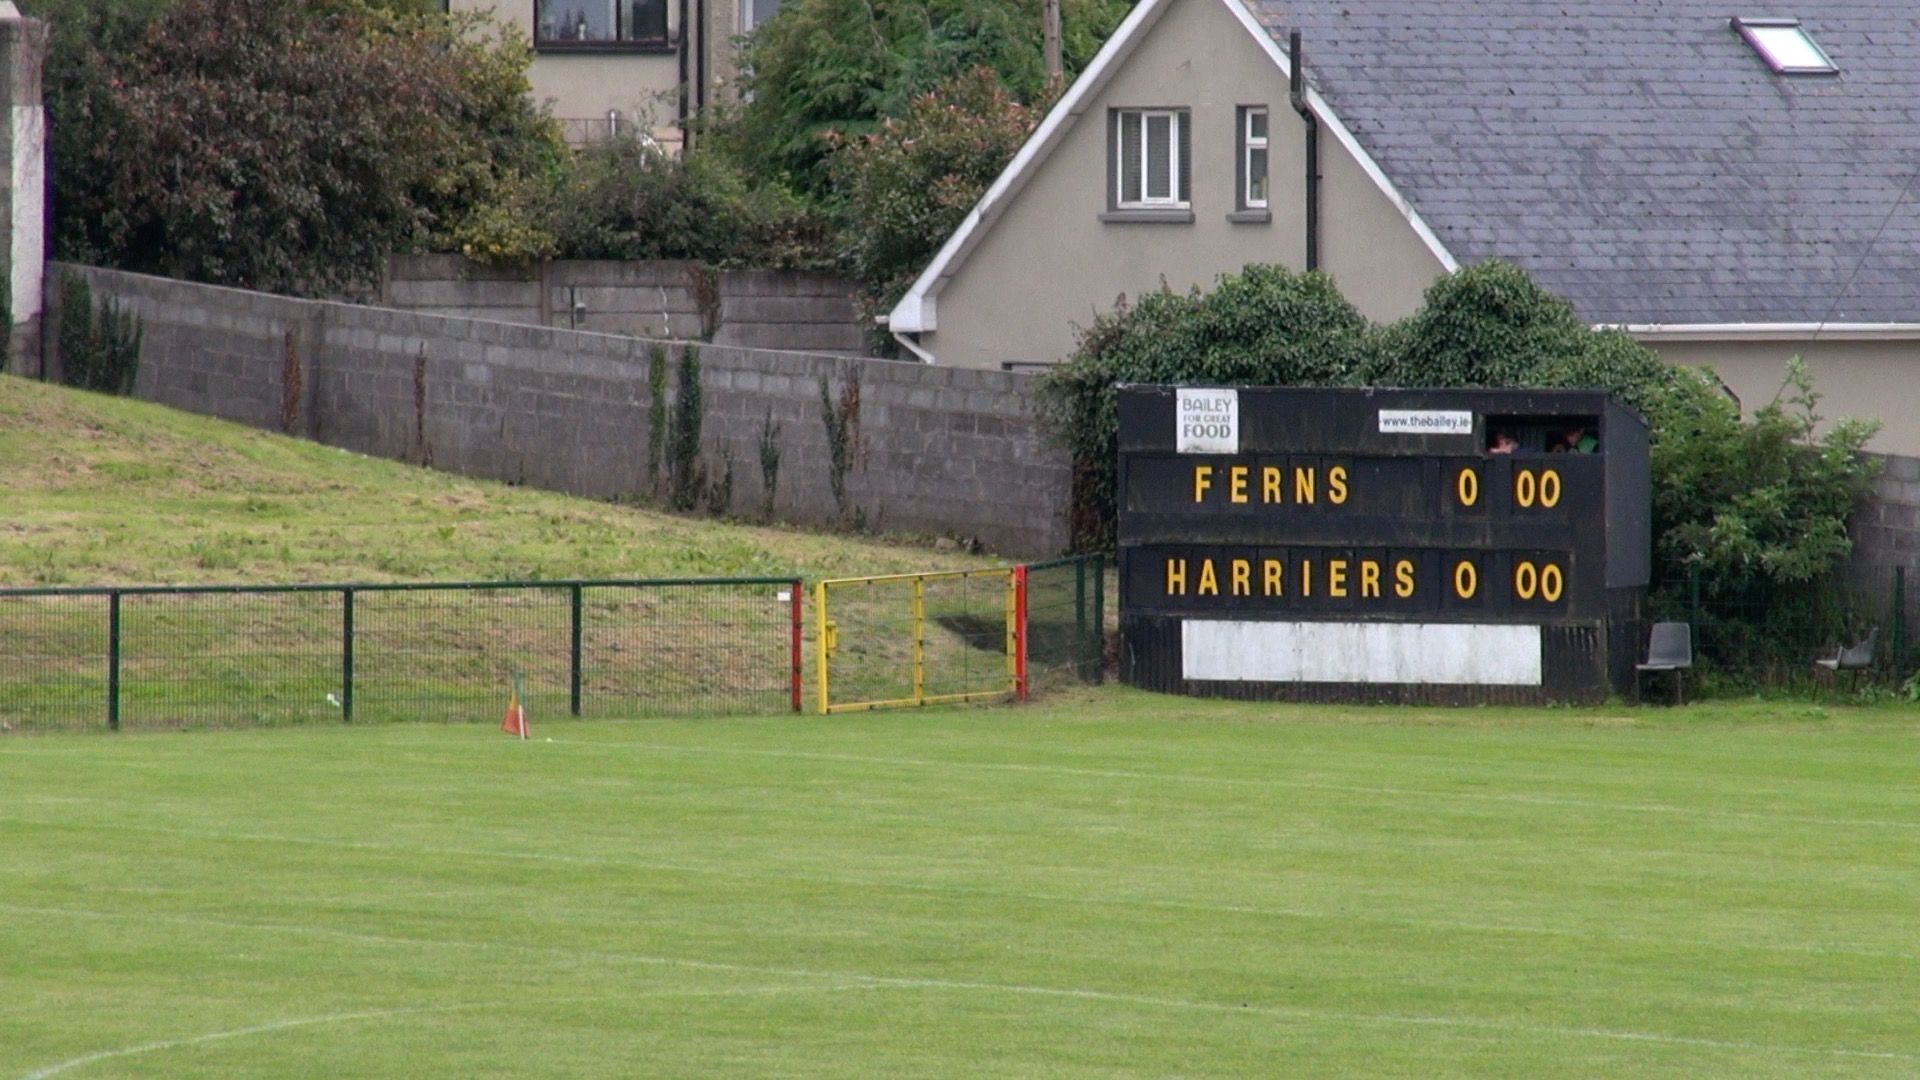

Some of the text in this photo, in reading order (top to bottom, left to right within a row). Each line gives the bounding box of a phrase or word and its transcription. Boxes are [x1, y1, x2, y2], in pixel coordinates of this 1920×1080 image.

[1182, 398, 1232, 412] BAILEY
[1183, 414, 1231, 423] FOR GREAT
[1383, 415, 1469, 430] www.thebailey.ie
[1183, 424, 1231, 439] FOOD
[1194, 466, 1561, 508] FERNS 0 00
[1167, 558, 1563, 602] HARRIERS 0 00
